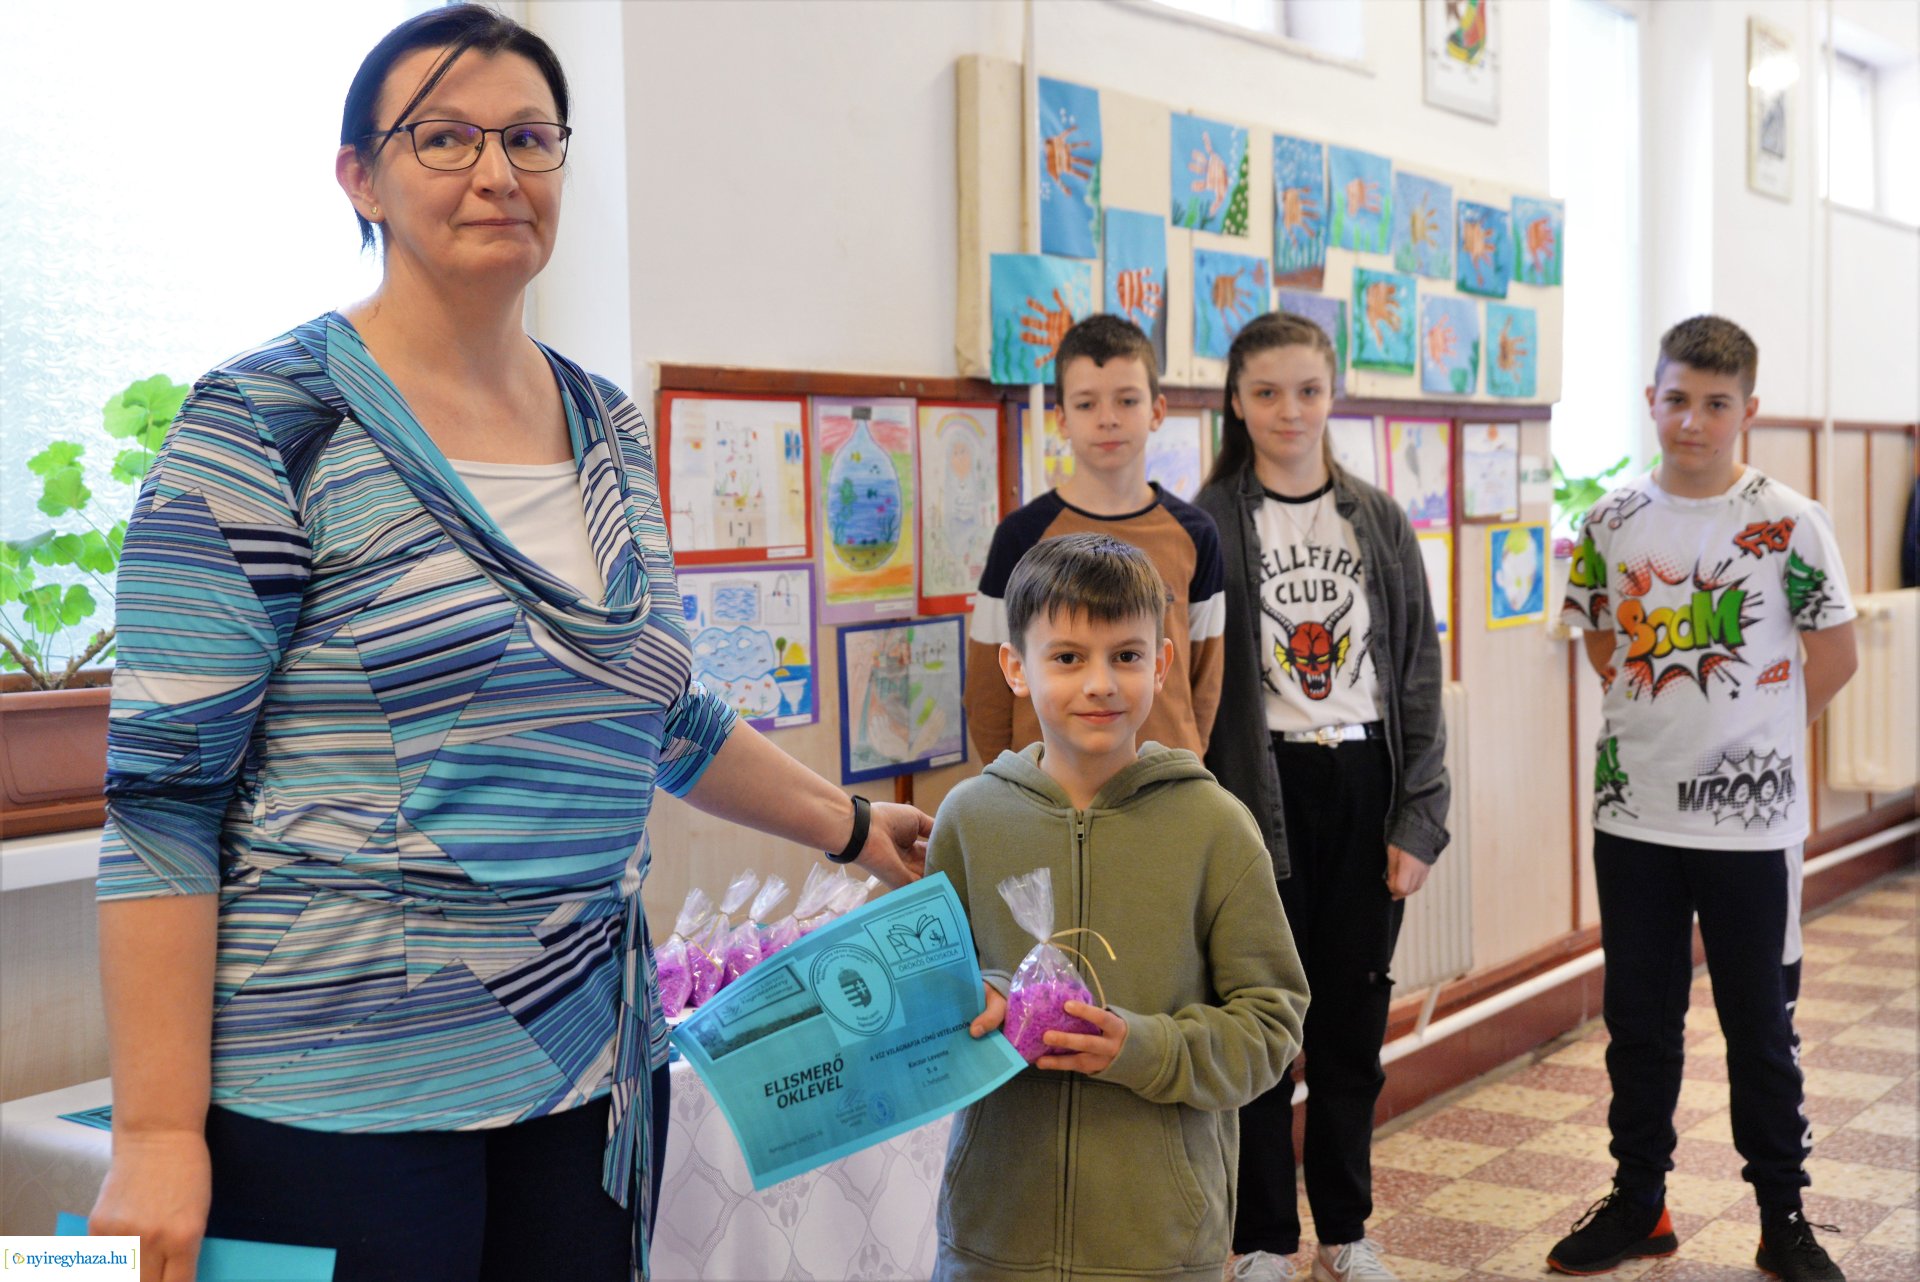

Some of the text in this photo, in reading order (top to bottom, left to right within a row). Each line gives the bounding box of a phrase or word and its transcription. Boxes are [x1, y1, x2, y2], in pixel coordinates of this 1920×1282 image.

[1275, 579, 1338, 605] CLUB
[1616, 588, 1747, 659] BOOM
[764, 1052, 844, 1098] ELISMERŐ
